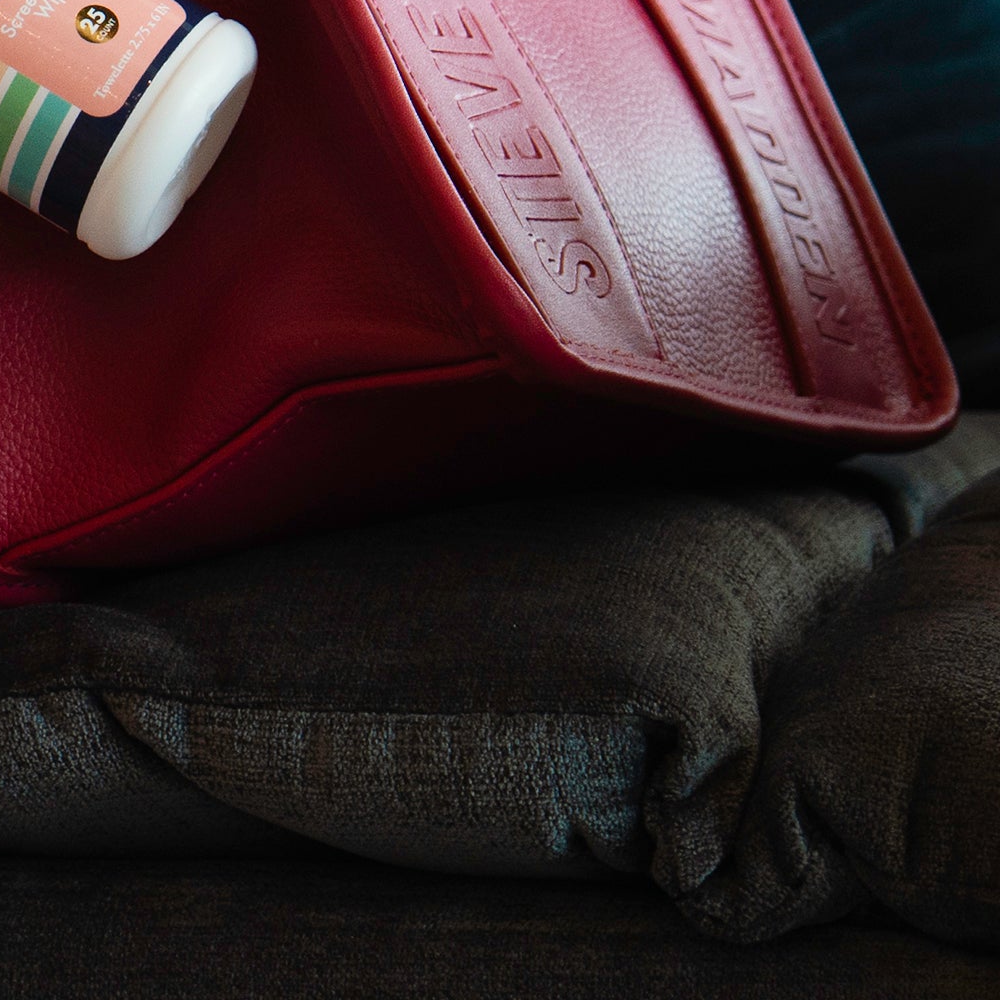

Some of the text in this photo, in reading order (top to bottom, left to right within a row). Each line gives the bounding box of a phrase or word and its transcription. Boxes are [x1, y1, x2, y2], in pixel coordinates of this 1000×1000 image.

[80, 7, 106, 35] 25
[93, 48, 135, 99] Towelette
[129, 26, 151, 49] 2.75
[153, 2, 170, 16] IN
[96, 17, 117, 41] COUNT
[404, 0, 612, 300] STEVE
